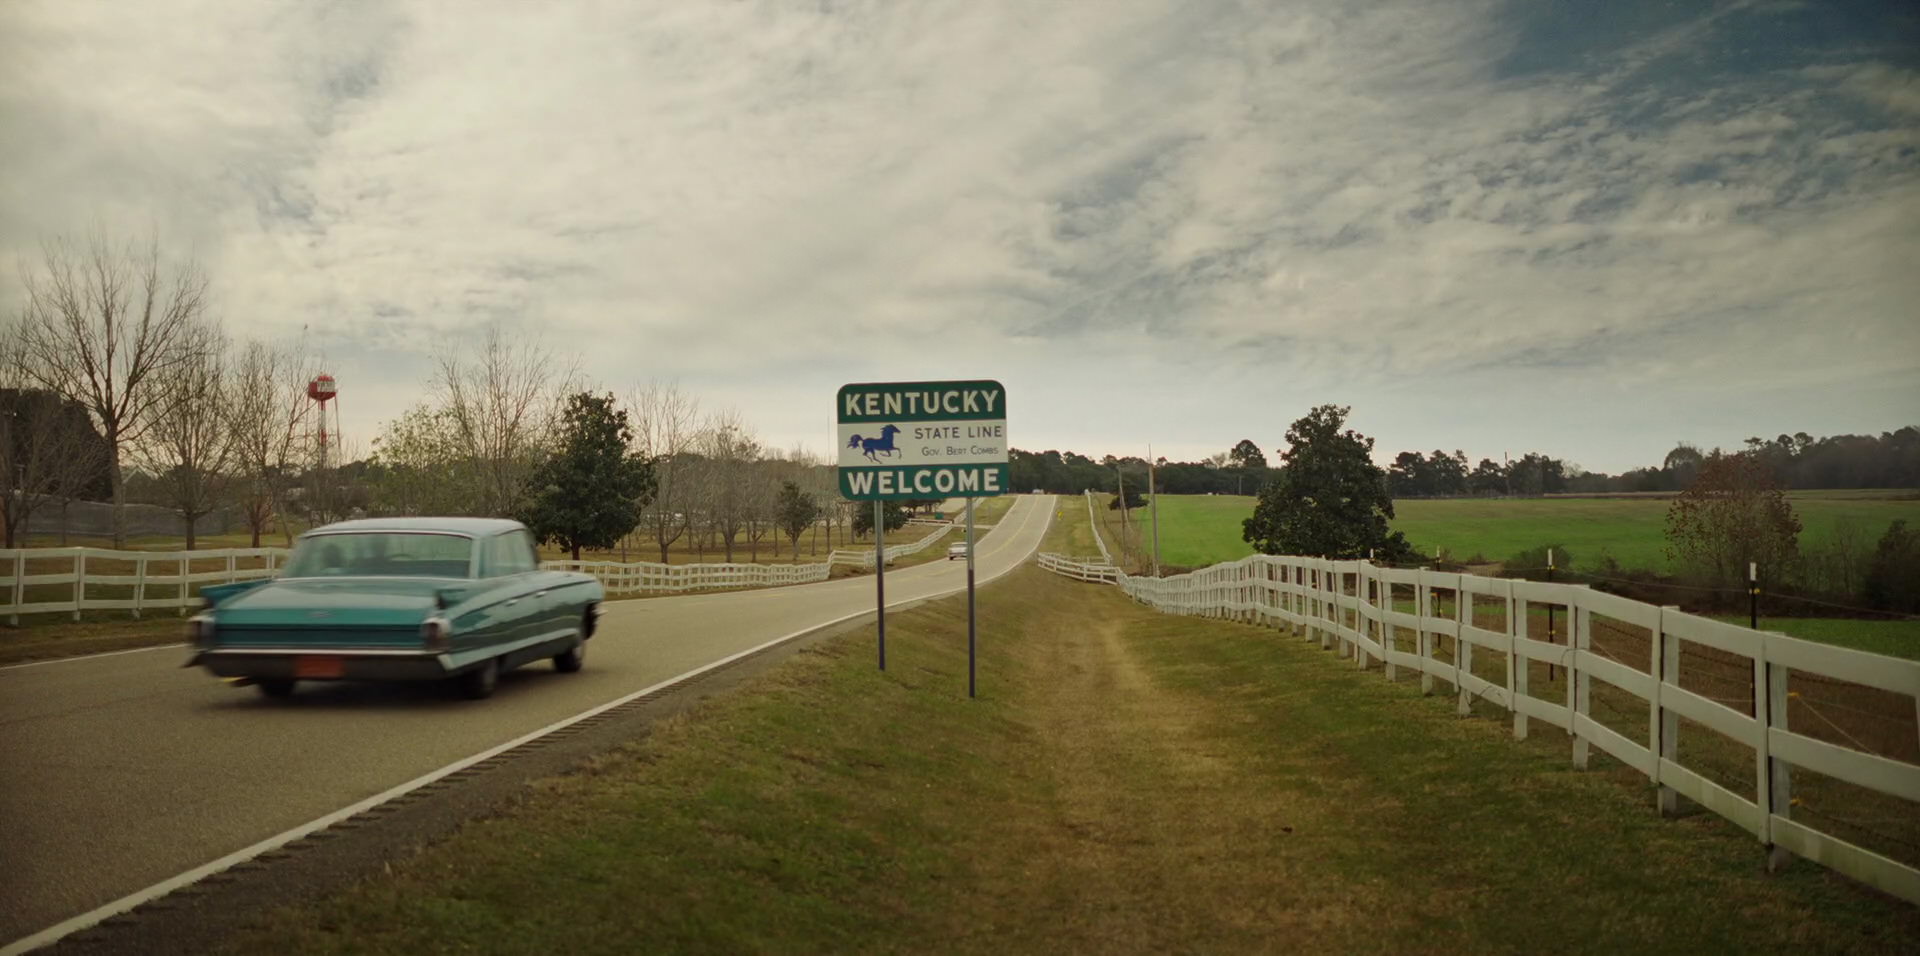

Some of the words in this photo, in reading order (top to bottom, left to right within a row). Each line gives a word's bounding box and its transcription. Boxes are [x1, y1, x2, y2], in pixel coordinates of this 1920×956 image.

[845, 390, 998, 416] KENTUCKY
[914, 427, 960, 439] STATE
[968, 425, 1002, 438] LINE
[847, 468, 1000, 495] WELCOME
